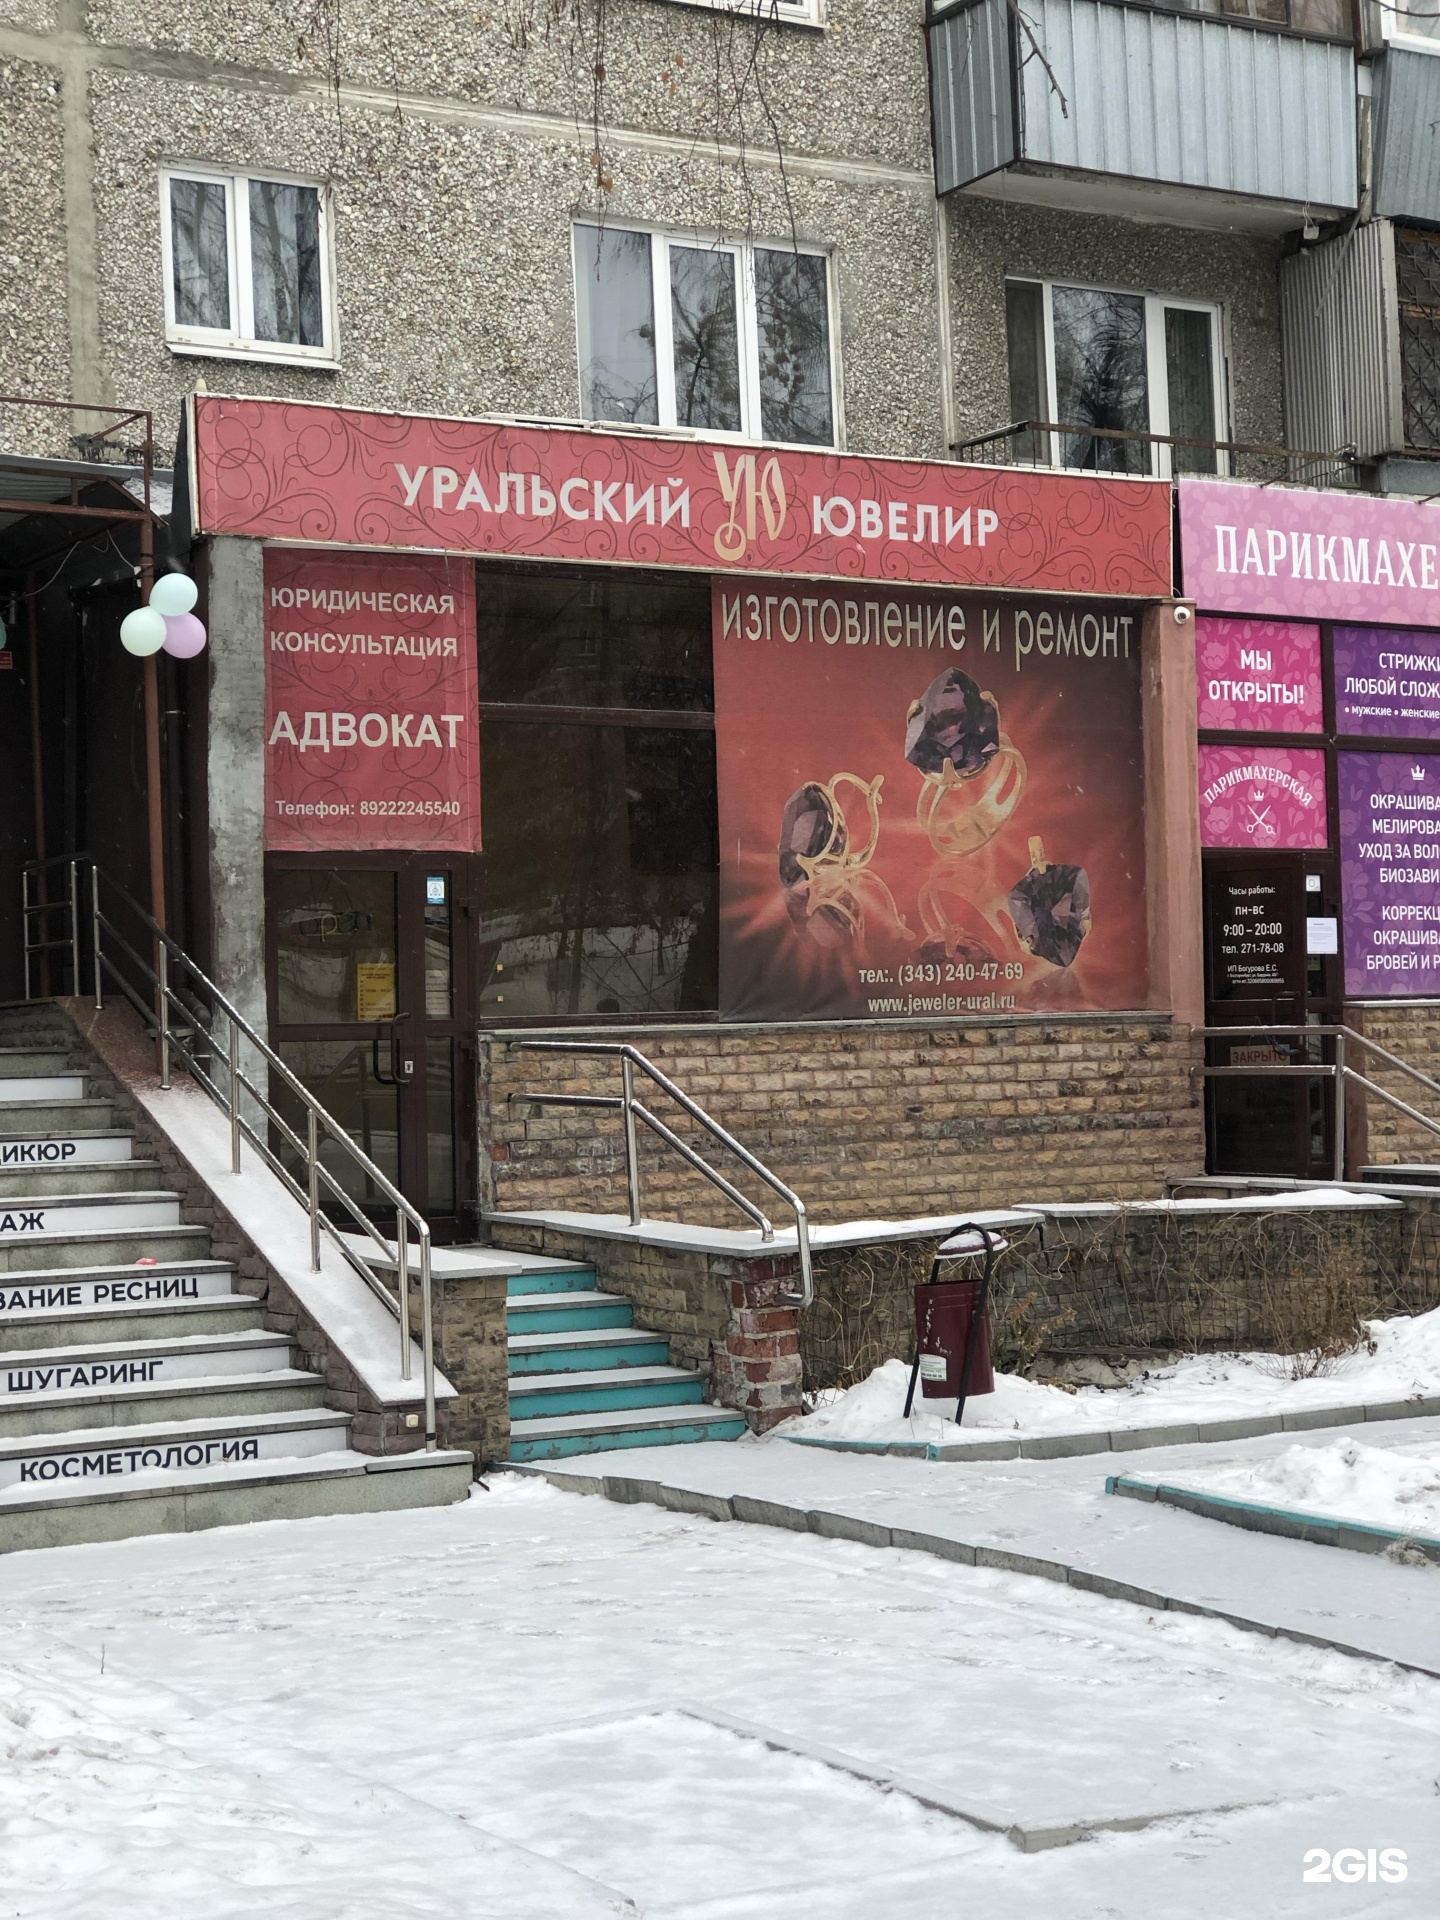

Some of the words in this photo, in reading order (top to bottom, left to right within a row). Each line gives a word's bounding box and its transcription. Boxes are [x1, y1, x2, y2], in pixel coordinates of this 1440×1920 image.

[394, 463, 691, 528] УРАЛЬСКИЙ
[813, 495, 999, 548] ЮВЕЛИР
[1214, 525, 1439, 590] ПАРИКМАХЕ
[271, 587, 455, 614] ЮРИДИЧЕСКАЯ
[721, 593, 967, 651] изготовление
[1015, 610, 1134, 672] ремонт
[270, 631, 458, 660] КОНСУЛЬТАЦИЯ
[1240, 649, 1272, 670] МЫ
[1208, 680, 1305, 705] ОТКРЫТЫ!
[1344, 676, 1397, 695] ЛЮБОЙ
[1400, 681, 1440, 698] СЛОЖ
[1351, 705, 1392, 717] мужские
[1400, 708, 1440, 719] женские
[269, 711, 464, 752] АДВОКАТ
[1203, 765, 1313, 807] ПАРИКМАХЕРСКАЯ
[275, 800, 355, 818] Телефон:
[360, 801, 460, 816] 89222245540
[1358, 843, 1393, 861] УХОД
[1395, 843, 1411, 858] ЗА
[1414, 844, 1440, 859] ВОЛ
[1380, 868, 1440, 883] БИОЗАВИ
[1228, 886, 1247, 895] Часы
[1248, 885, 1276, 896] работы:
[1223, 924, 1244, 936] 9:00
[1255, 922, 1282, 936] 20:00
[1221, 945, 1239, 954] тел.
[1241, 942, 1285, 954] 271-78-08
[1367, 952, 1418, 970] БРОВЕЙ
[1421, 955, 1430, 969] И
[898, 963, 942, 987] (343)
[945, 962, 1024, 982] 240-47-69
[868, 991, 1015, 1016] www.jeweler-ural.ru
[0, 1143, 76, 1165] ИКЮР
[94, 1278, 199, 1303] РЕСНИЦ
[8, 1361, 163, 1391] ШУГАРИНГ
[20, 1439, 259, 1482] КОСМЕТОЛОГИЯ
